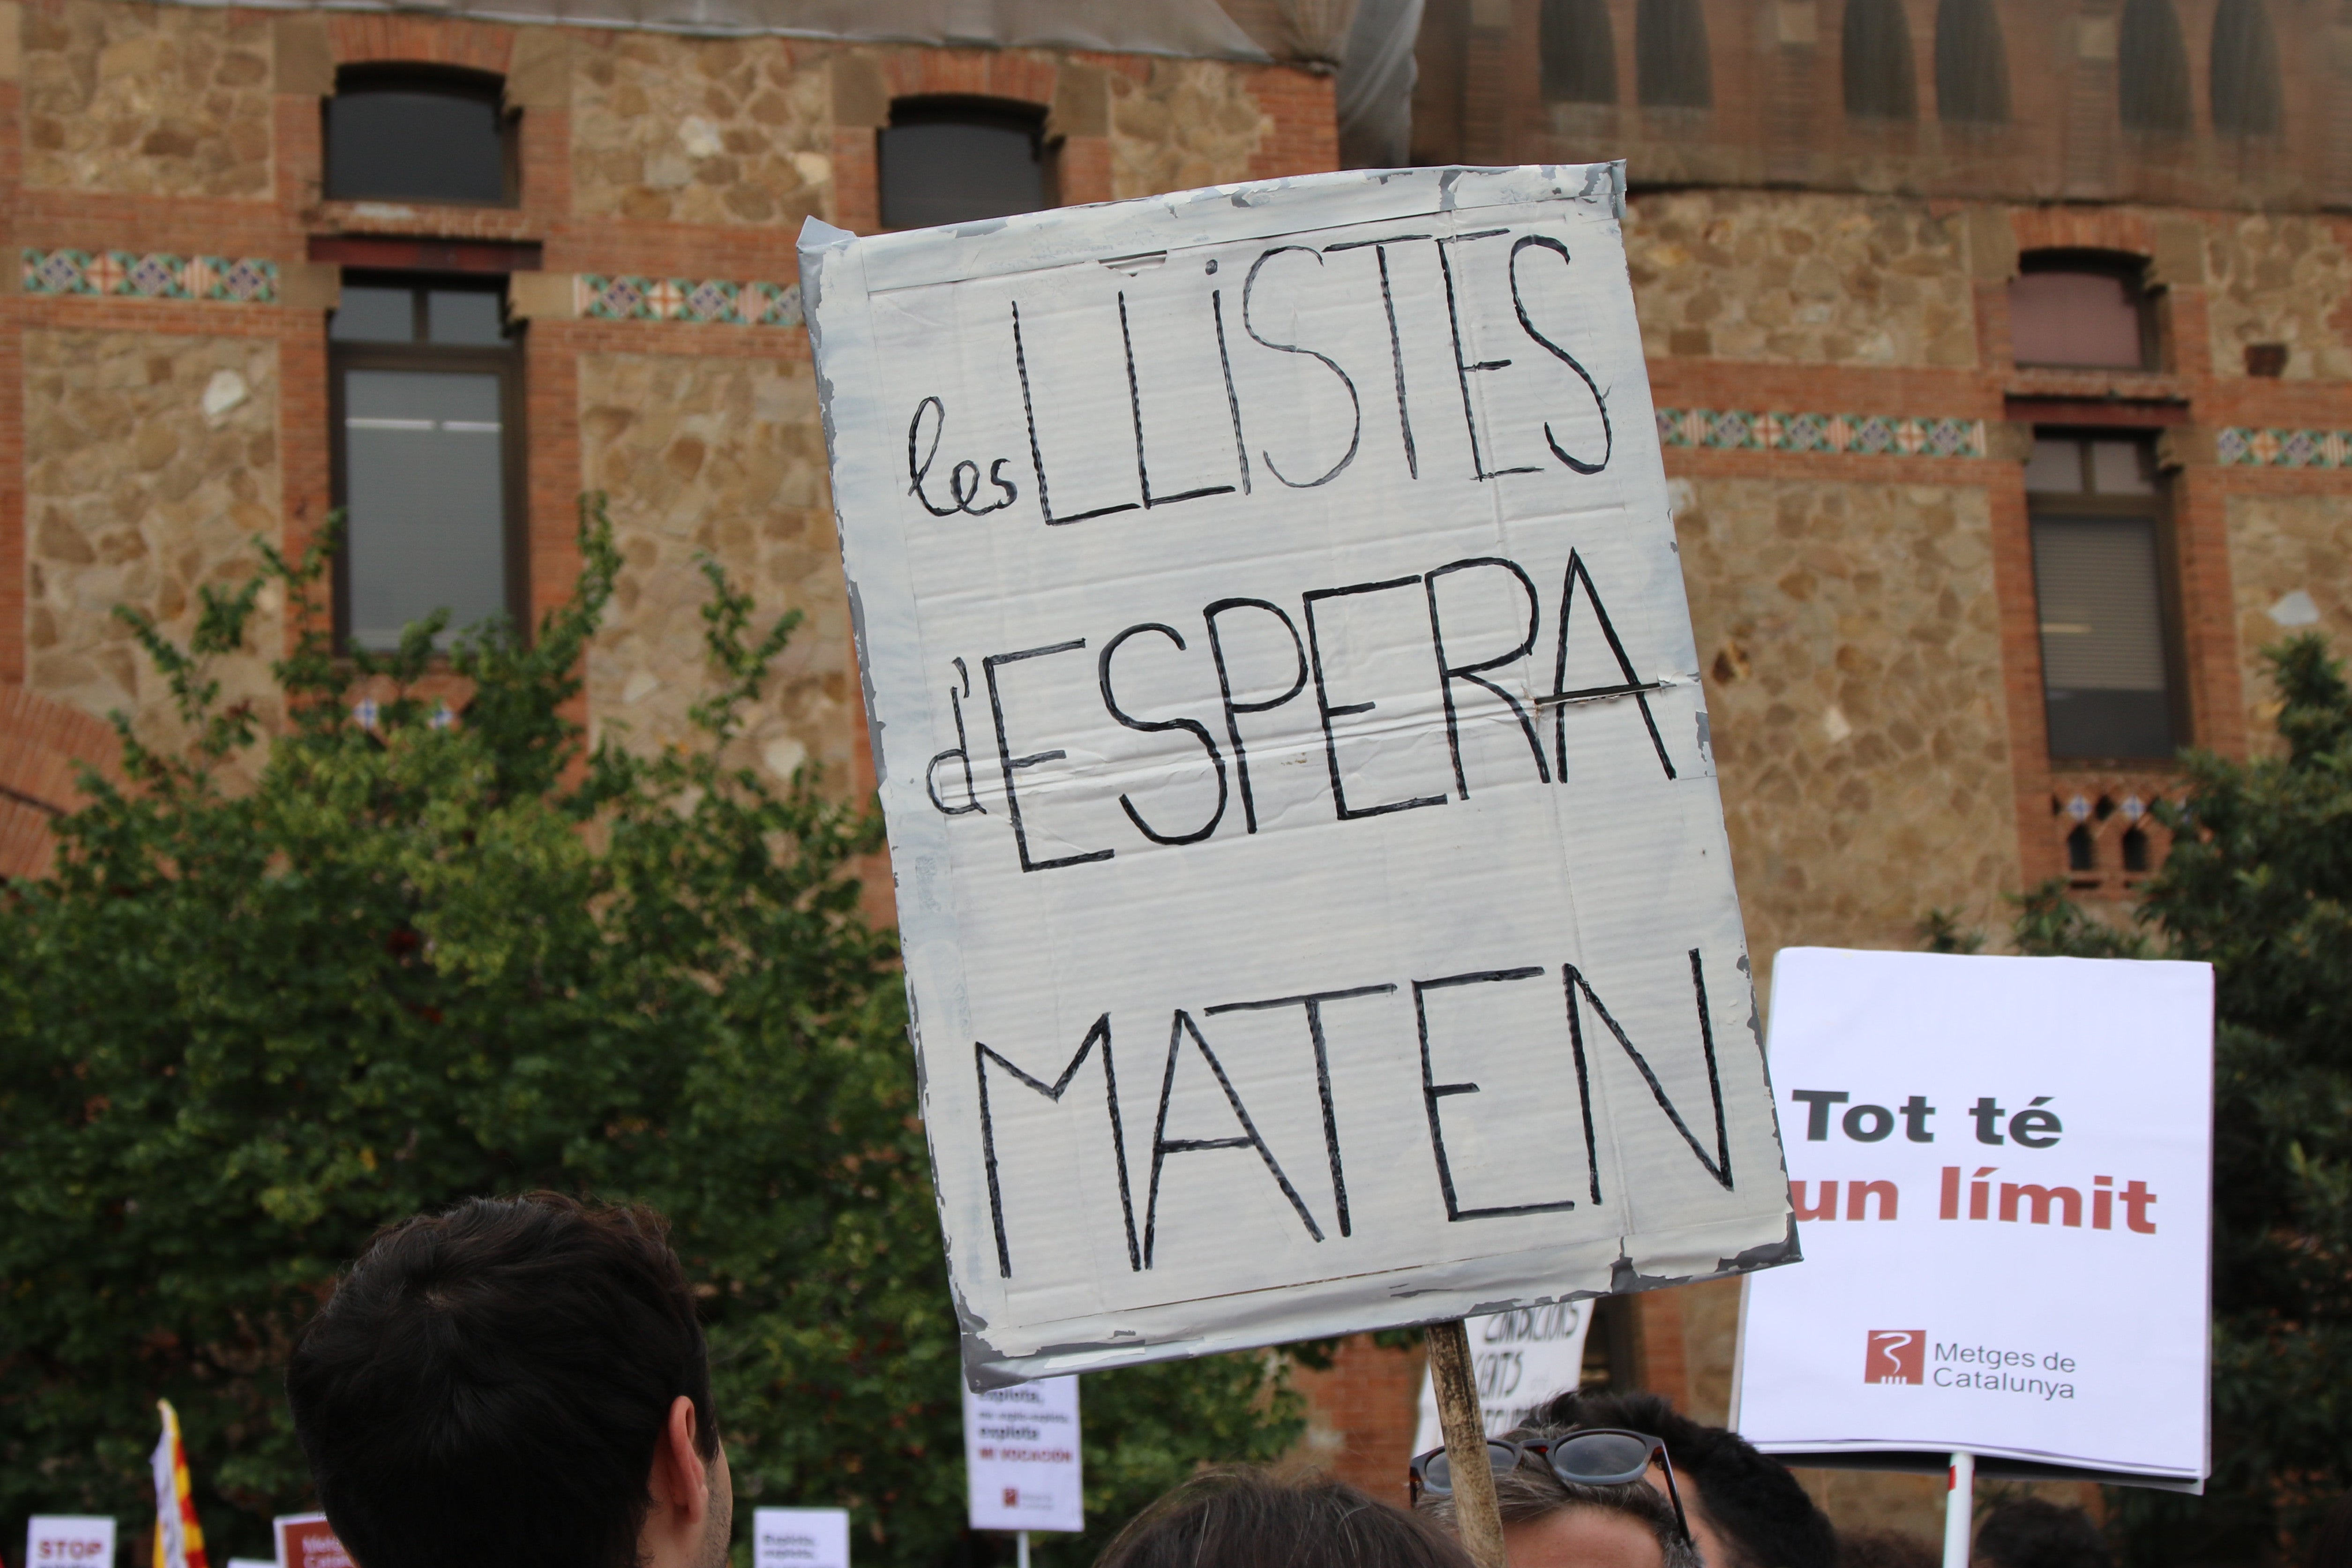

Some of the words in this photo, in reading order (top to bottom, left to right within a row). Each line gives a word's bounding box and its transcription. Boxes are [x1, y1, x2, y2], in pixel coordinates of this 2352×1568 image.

[908, 395, 1018, 517] les
[926, 546, 1677, 872] d'ESPERA
[975, 948, 1734, 1278] MATEN
[1792, 1089, 1936, 1143] Tot
[1968, 1096, 2063, 1148] té
[1789, 1178, 1899, 1222] un
[1939, 1166, 2157, 1235] límit
[1933, 1366, 2076, 1401] Catalunya
[1934, 1342, 2036, 1371] Metges
[2042, 1350, 2076, 1373] de
[37, 1539, 103, 1560] STOP
